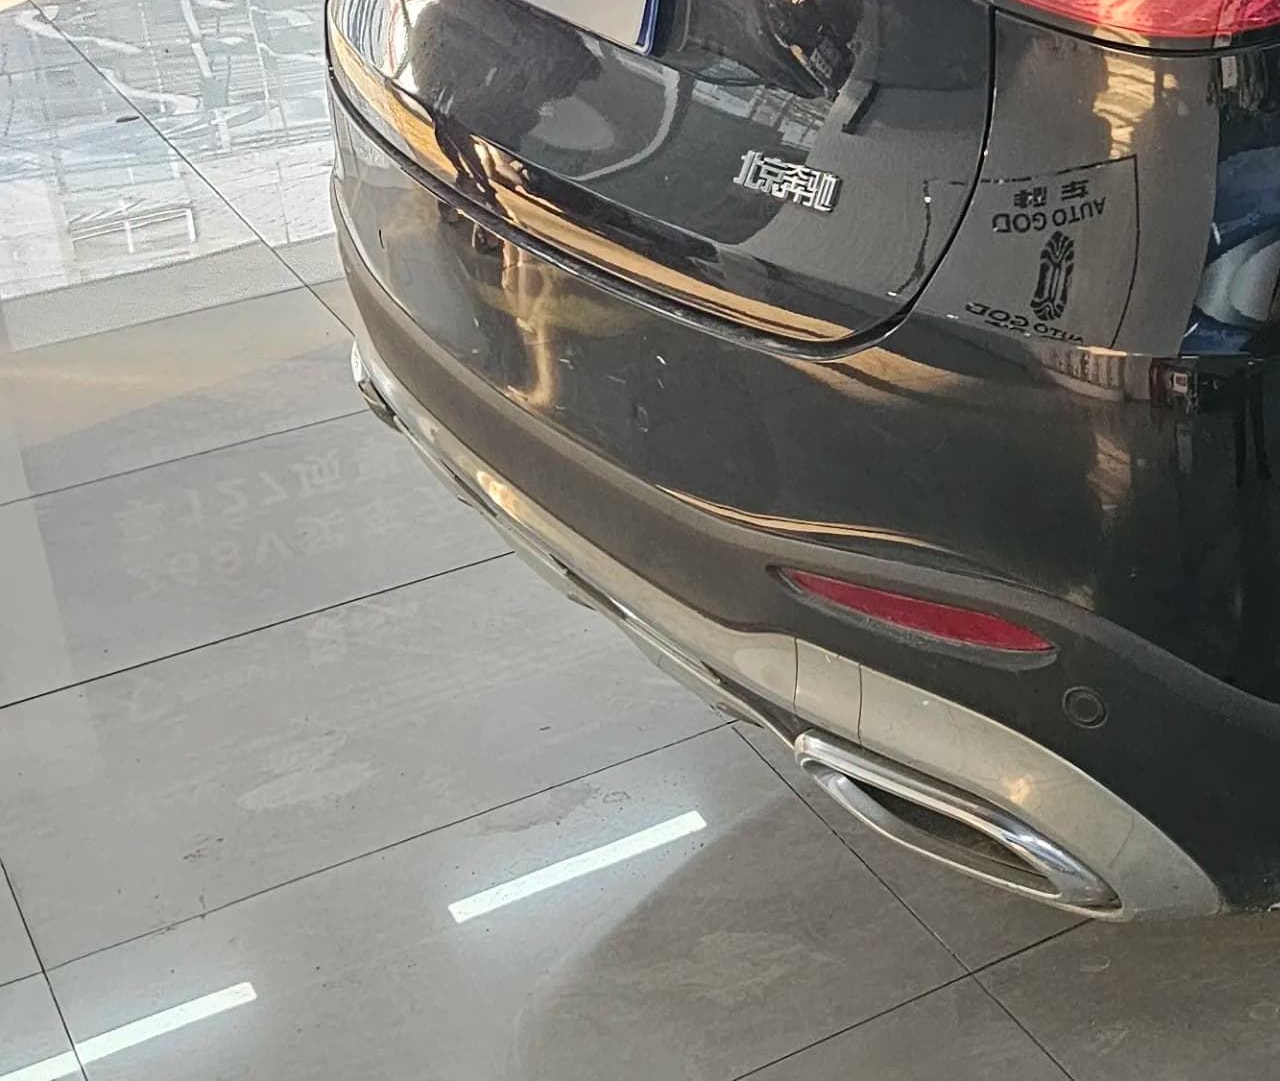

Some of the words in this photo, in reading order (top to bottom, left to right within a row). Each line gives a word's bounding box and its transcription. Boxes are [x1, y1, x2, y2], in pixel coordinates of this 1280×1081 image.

[733, 150, 838, 212] 北京奔驰
[992, 212, 1047, 233] GOD
[1052, 197, 1106, 227] AUTO
